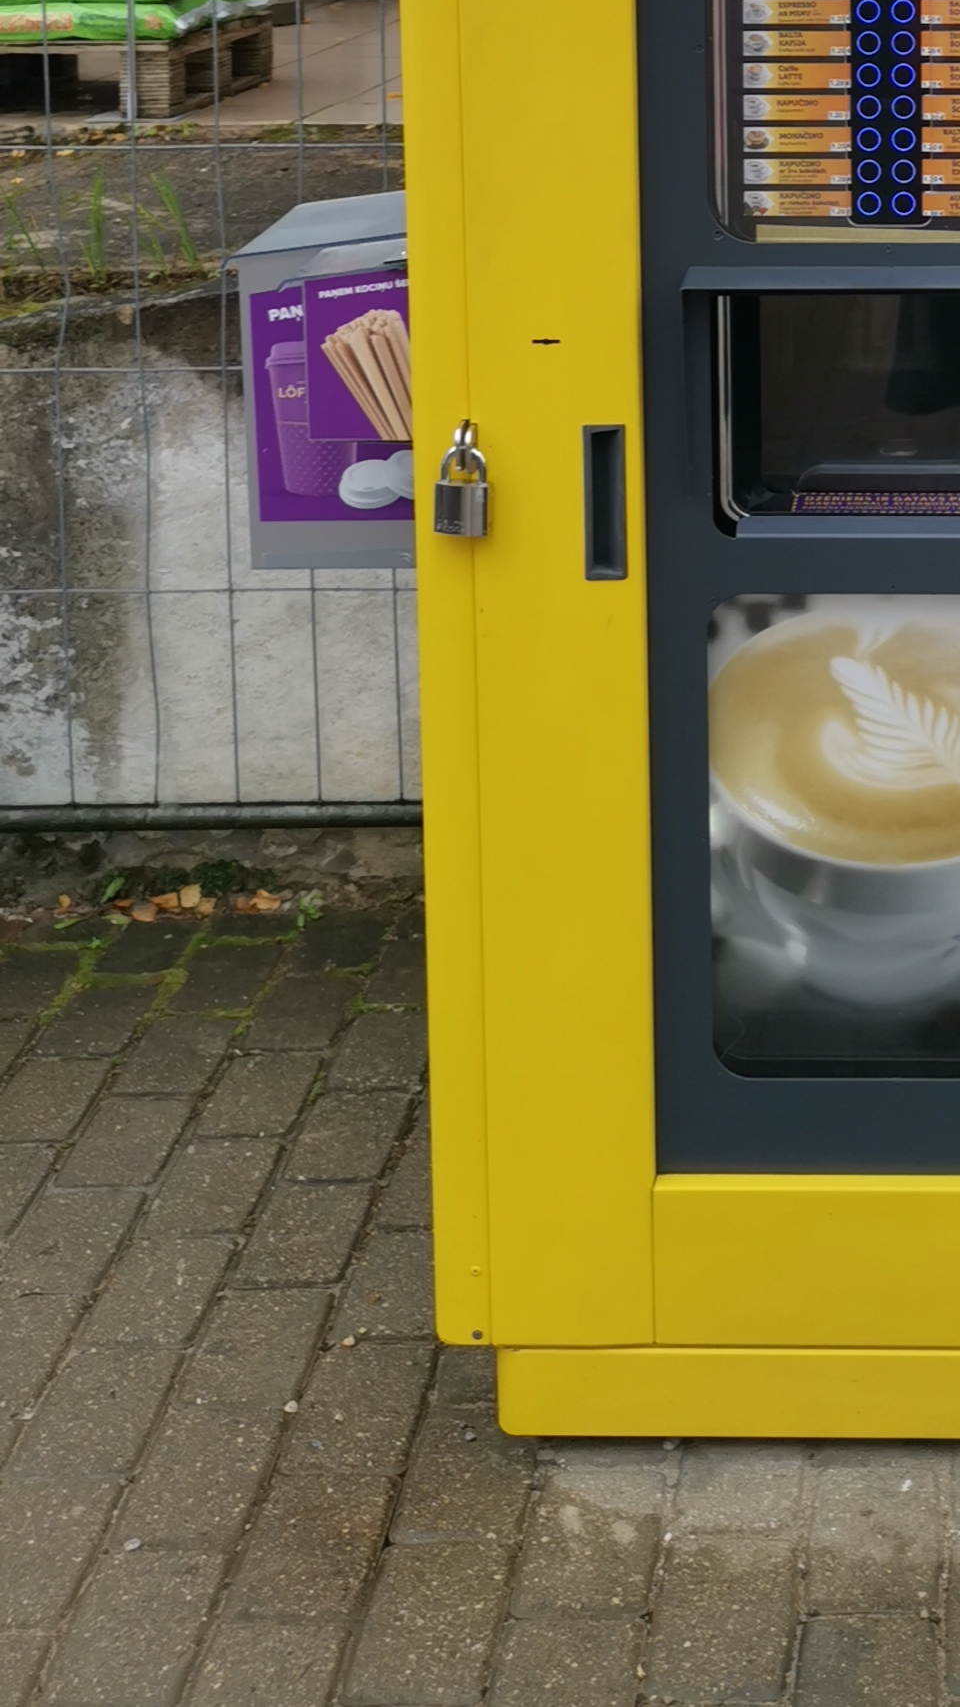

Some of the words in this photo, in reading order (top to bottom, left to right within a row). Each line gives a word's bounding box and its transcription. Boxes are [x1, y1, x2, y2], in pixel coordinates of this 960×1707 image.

[318, 286, 354, 299] PAŅEM
[395, 277, 409, 288] ŠE
[267, 304, 304, 322] PAŅ
